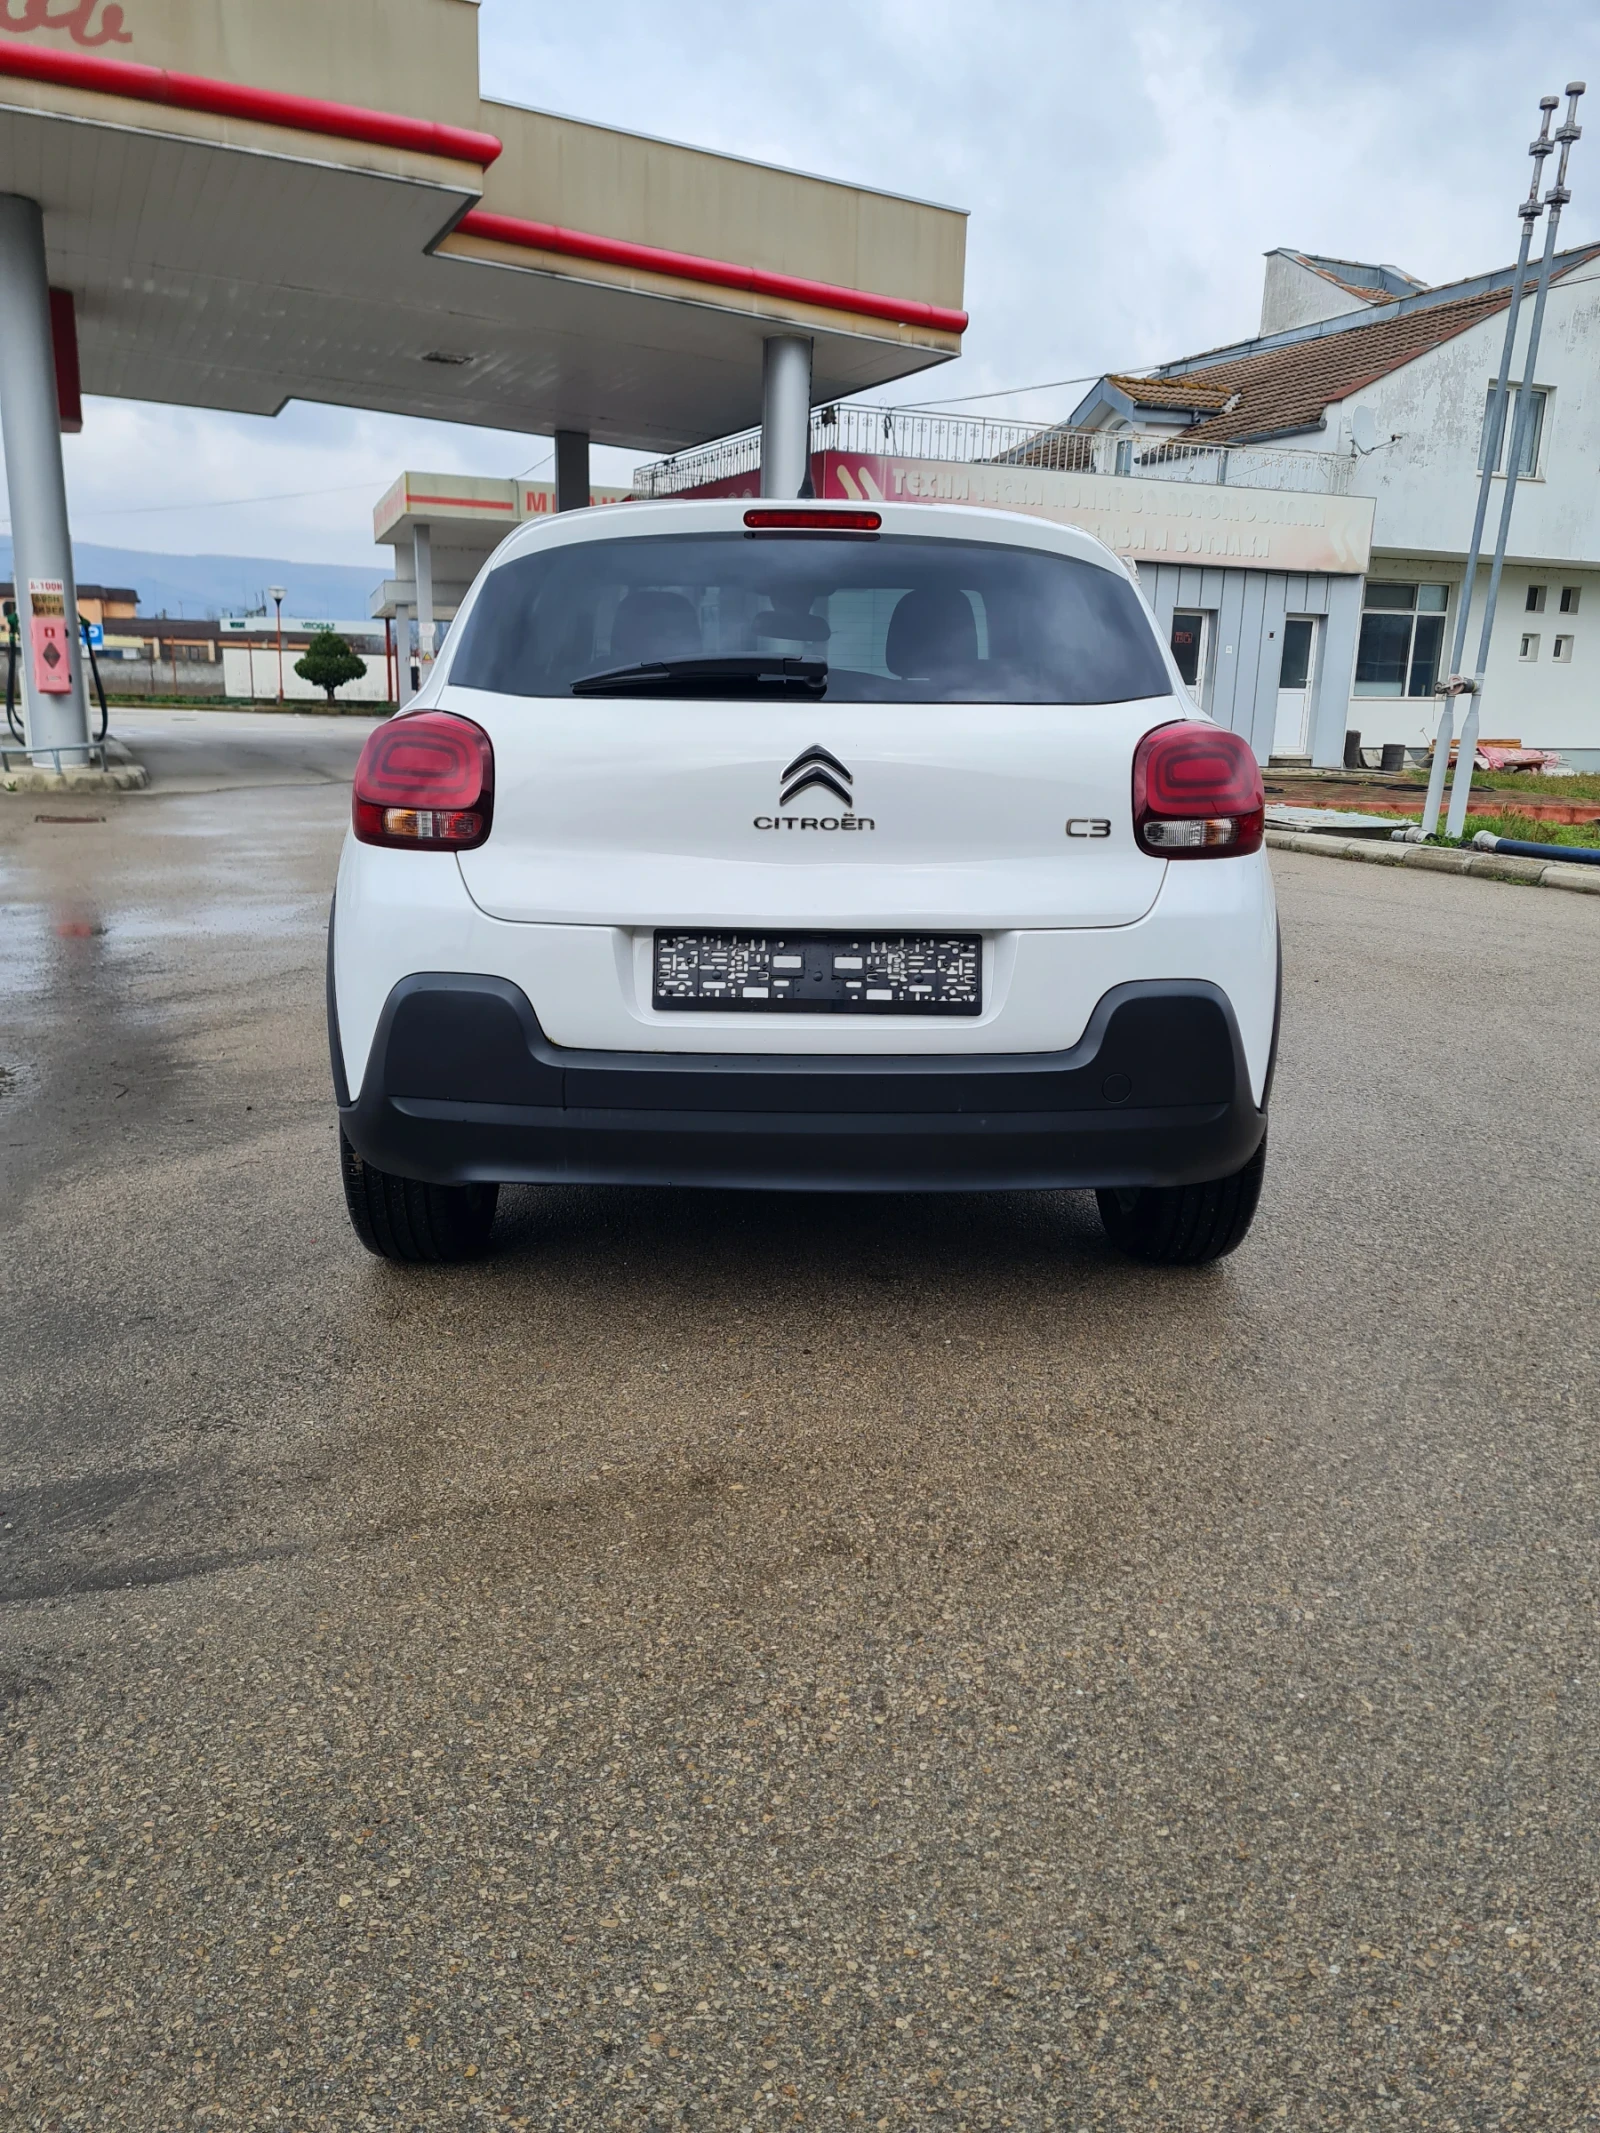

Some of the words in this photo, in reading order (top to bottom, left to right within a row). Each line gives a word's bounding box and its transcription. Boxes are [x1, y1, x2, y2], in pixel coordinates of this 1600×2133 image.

[892, 468, 1044, 506] ТЕХНИЧЕСКИ
[301, 621, 335, 631] VITOGAZ
[1065, 818, 1112, 839] C3
